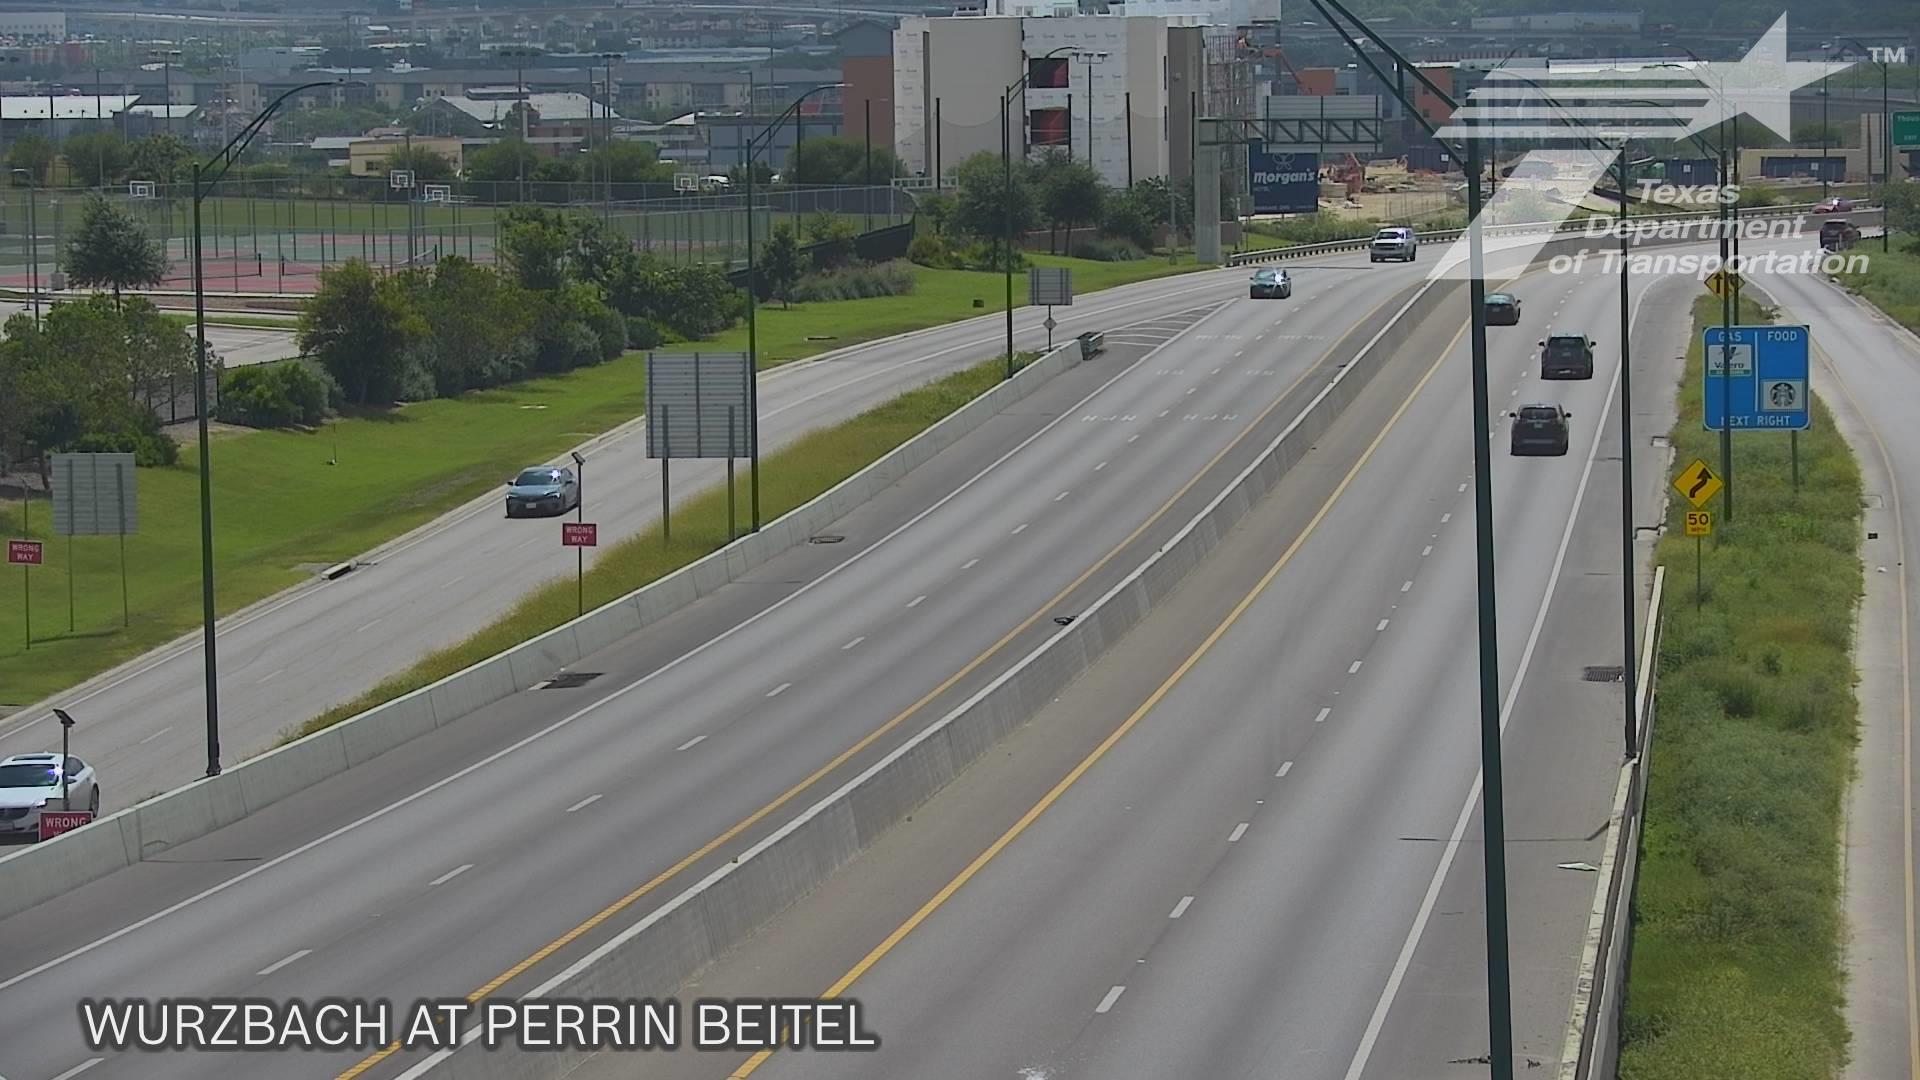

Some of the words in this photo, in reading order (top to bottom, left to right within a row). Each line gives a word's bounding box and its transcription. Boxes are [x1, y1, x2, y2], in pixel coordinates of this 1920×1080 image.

[1767, 330, 1797, 341] FOOD
[1757, 416, 1790, 426] RIGHT
[1688, 513, 1708, 525] 50
[45, 817, 87, 827] WRONG
